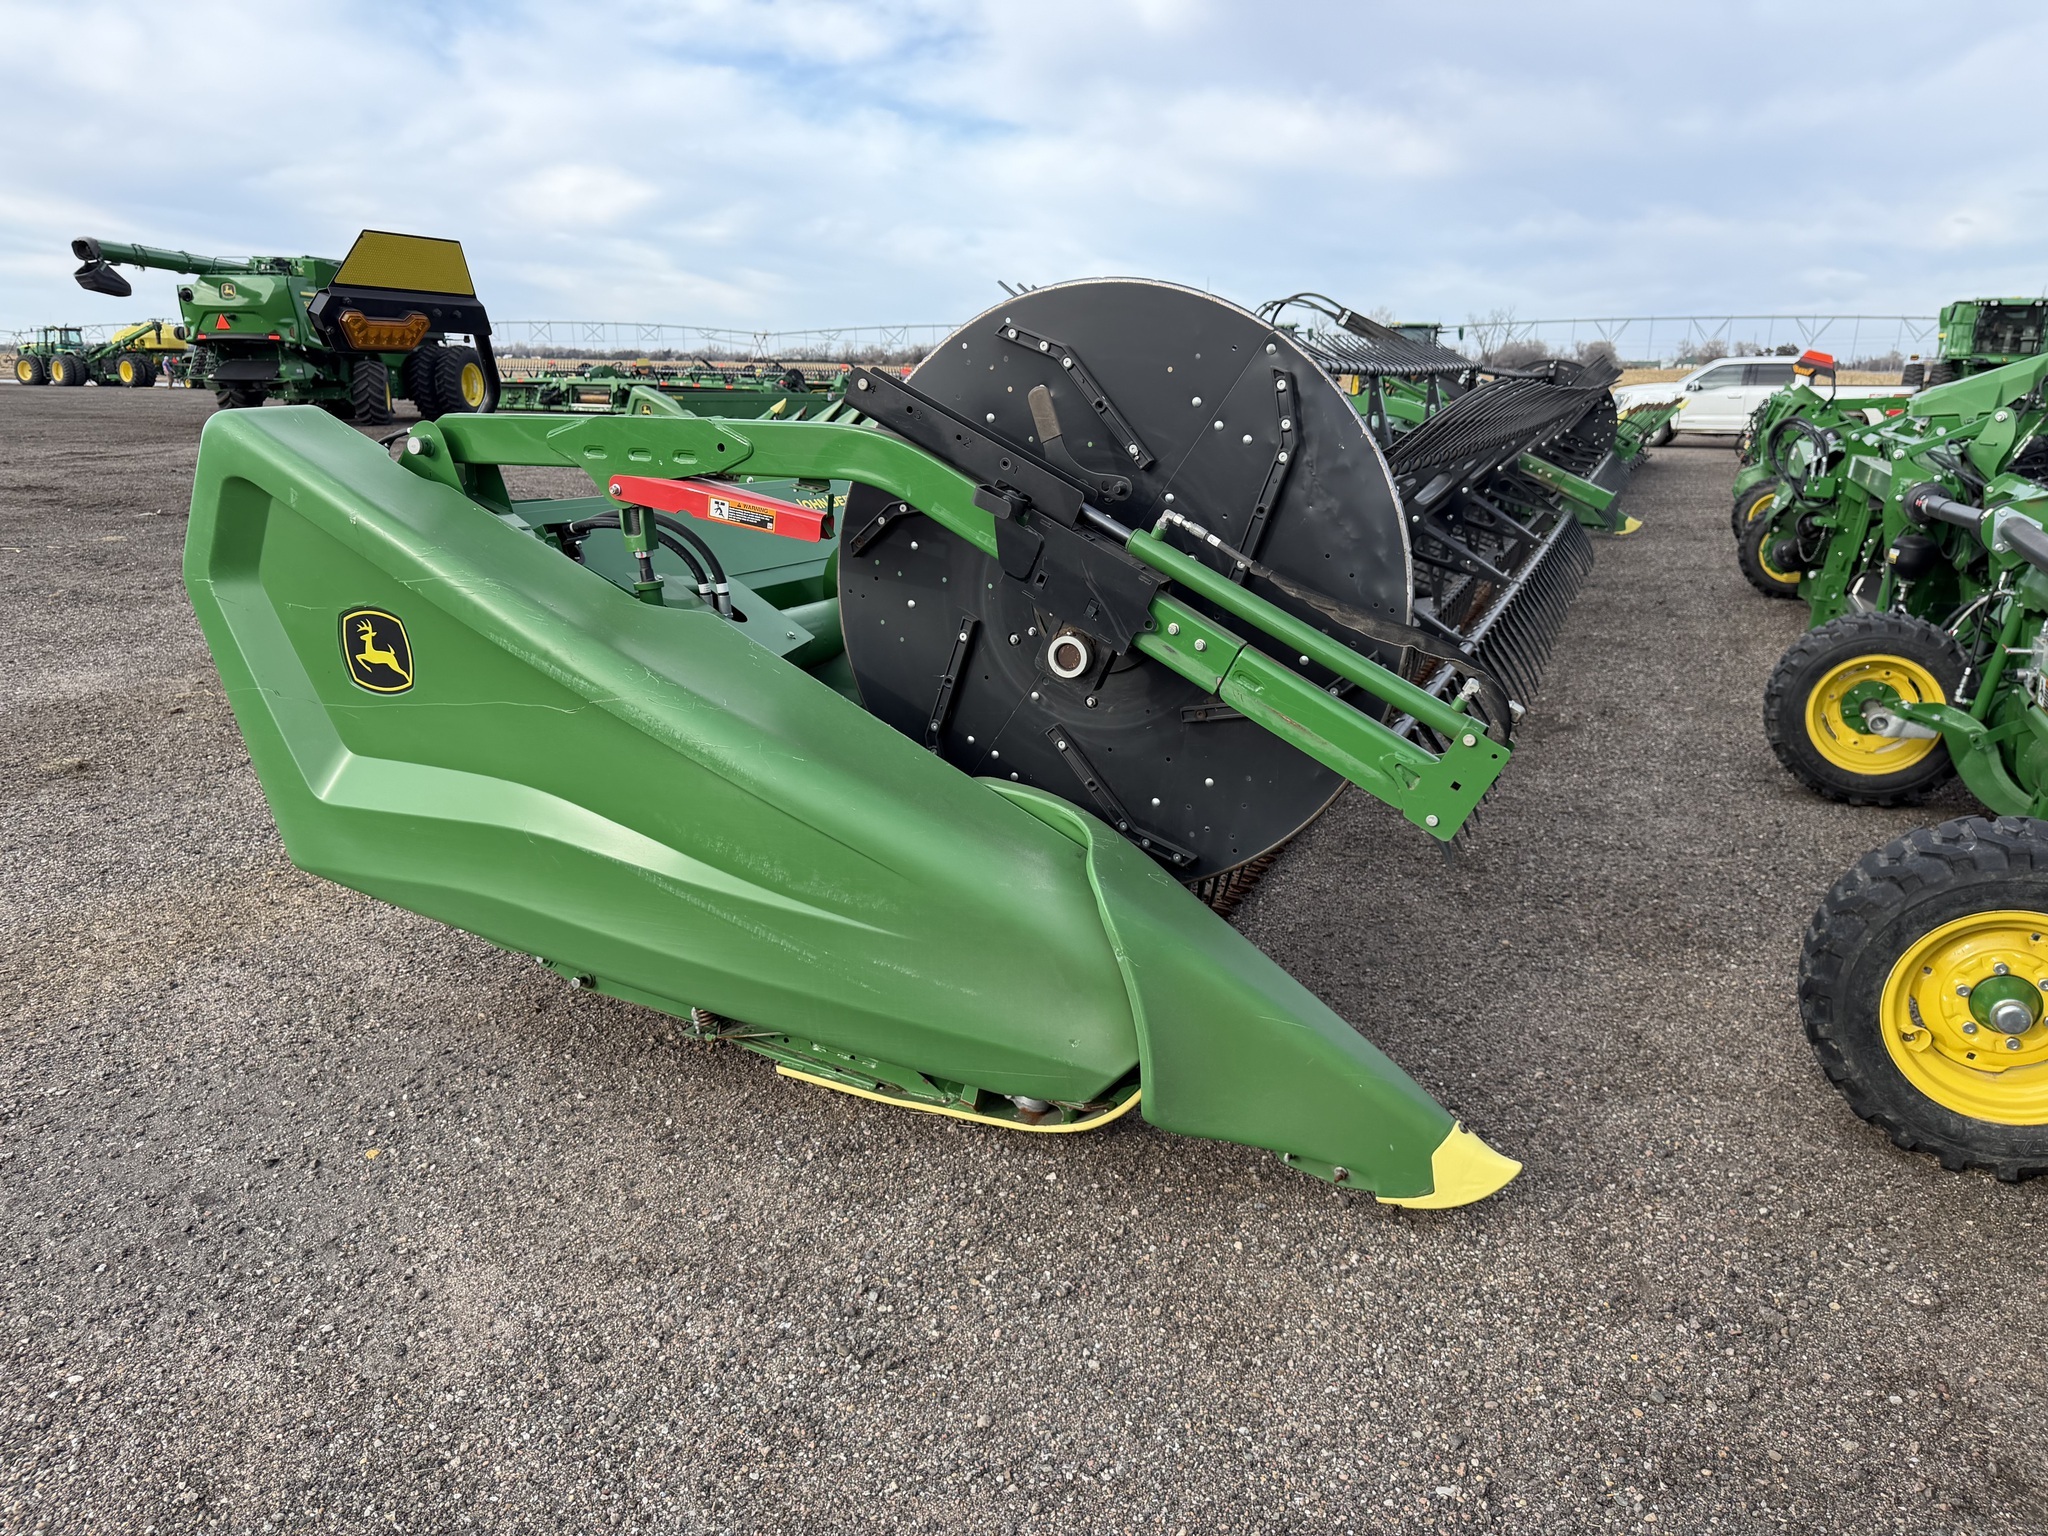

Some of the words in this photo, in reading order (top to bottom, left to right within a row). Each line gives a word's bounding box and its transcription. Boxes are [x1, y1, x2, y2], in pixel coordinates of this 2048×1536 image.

[869, 384, 877, 394] 4
[913, 409, 923, 420] 3
[963, 437, 972, 449] 2
[743, 503, 769, 514] WARNING
